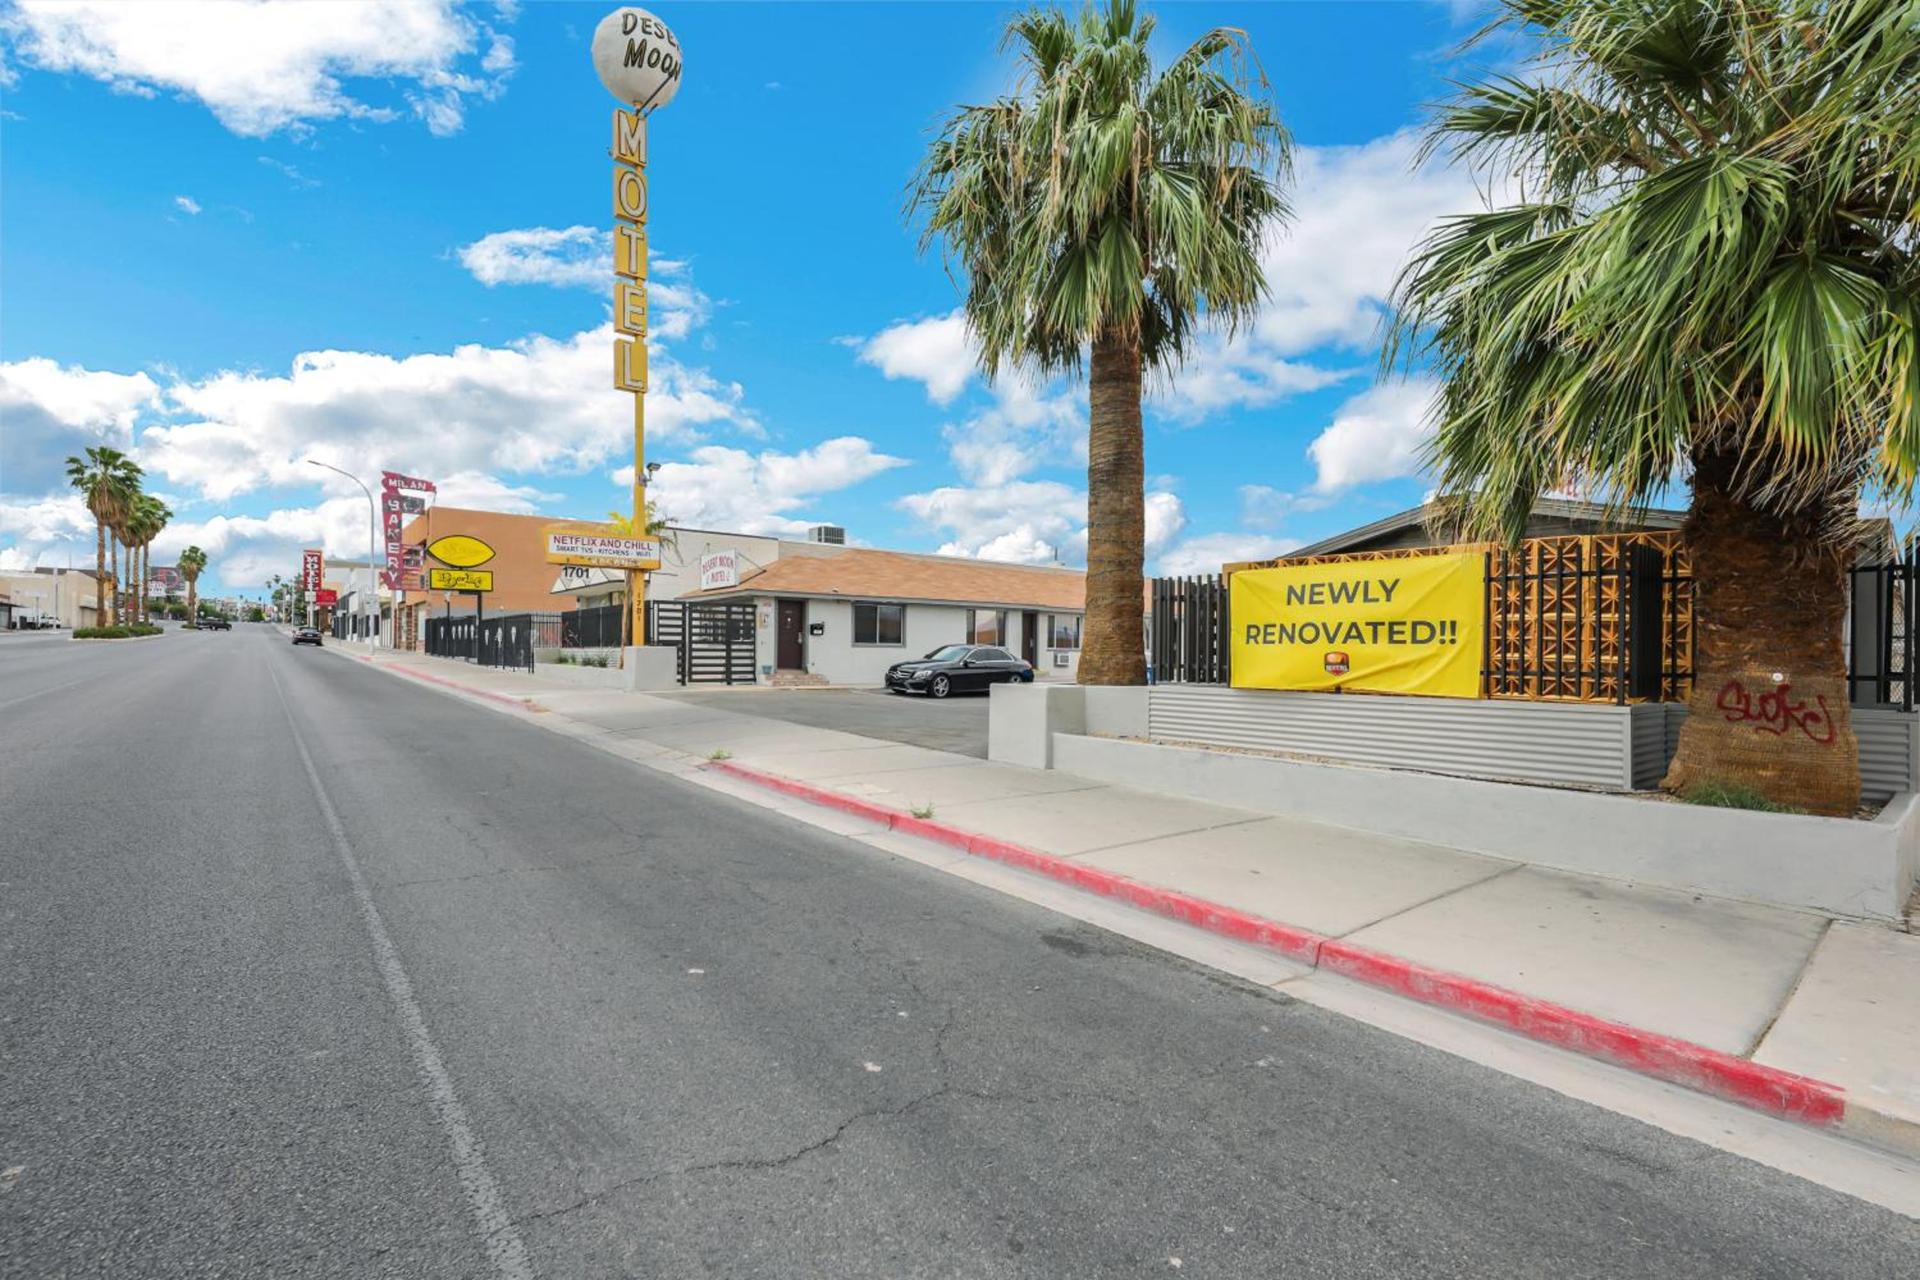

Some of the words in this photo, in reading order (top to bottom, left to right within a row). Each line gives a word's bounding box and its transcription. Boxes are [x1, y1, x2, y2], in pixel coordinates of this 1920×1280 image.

[622, 12, 678, 51] DESE
[623, 37, 682, 82] MOON
[617, 110, 647, 390] MOTEL
[388, 478, 426, 490] MILAN
[387, 499, 400, 582] BAKERY
[553, 535, 597, 546] NETFLIX
[600, 539, 622, 548] AND
[624, 540, 653, 551] CHILL
[556, 545, 579, 553] SMART
[598, 548, 630, 556] KITCHENS
[563, 566, 590, 578] 1701
[1286, 578, 1401, 606] NEWLY
[1245, 619, 1458, 645] RENOVATED!!
